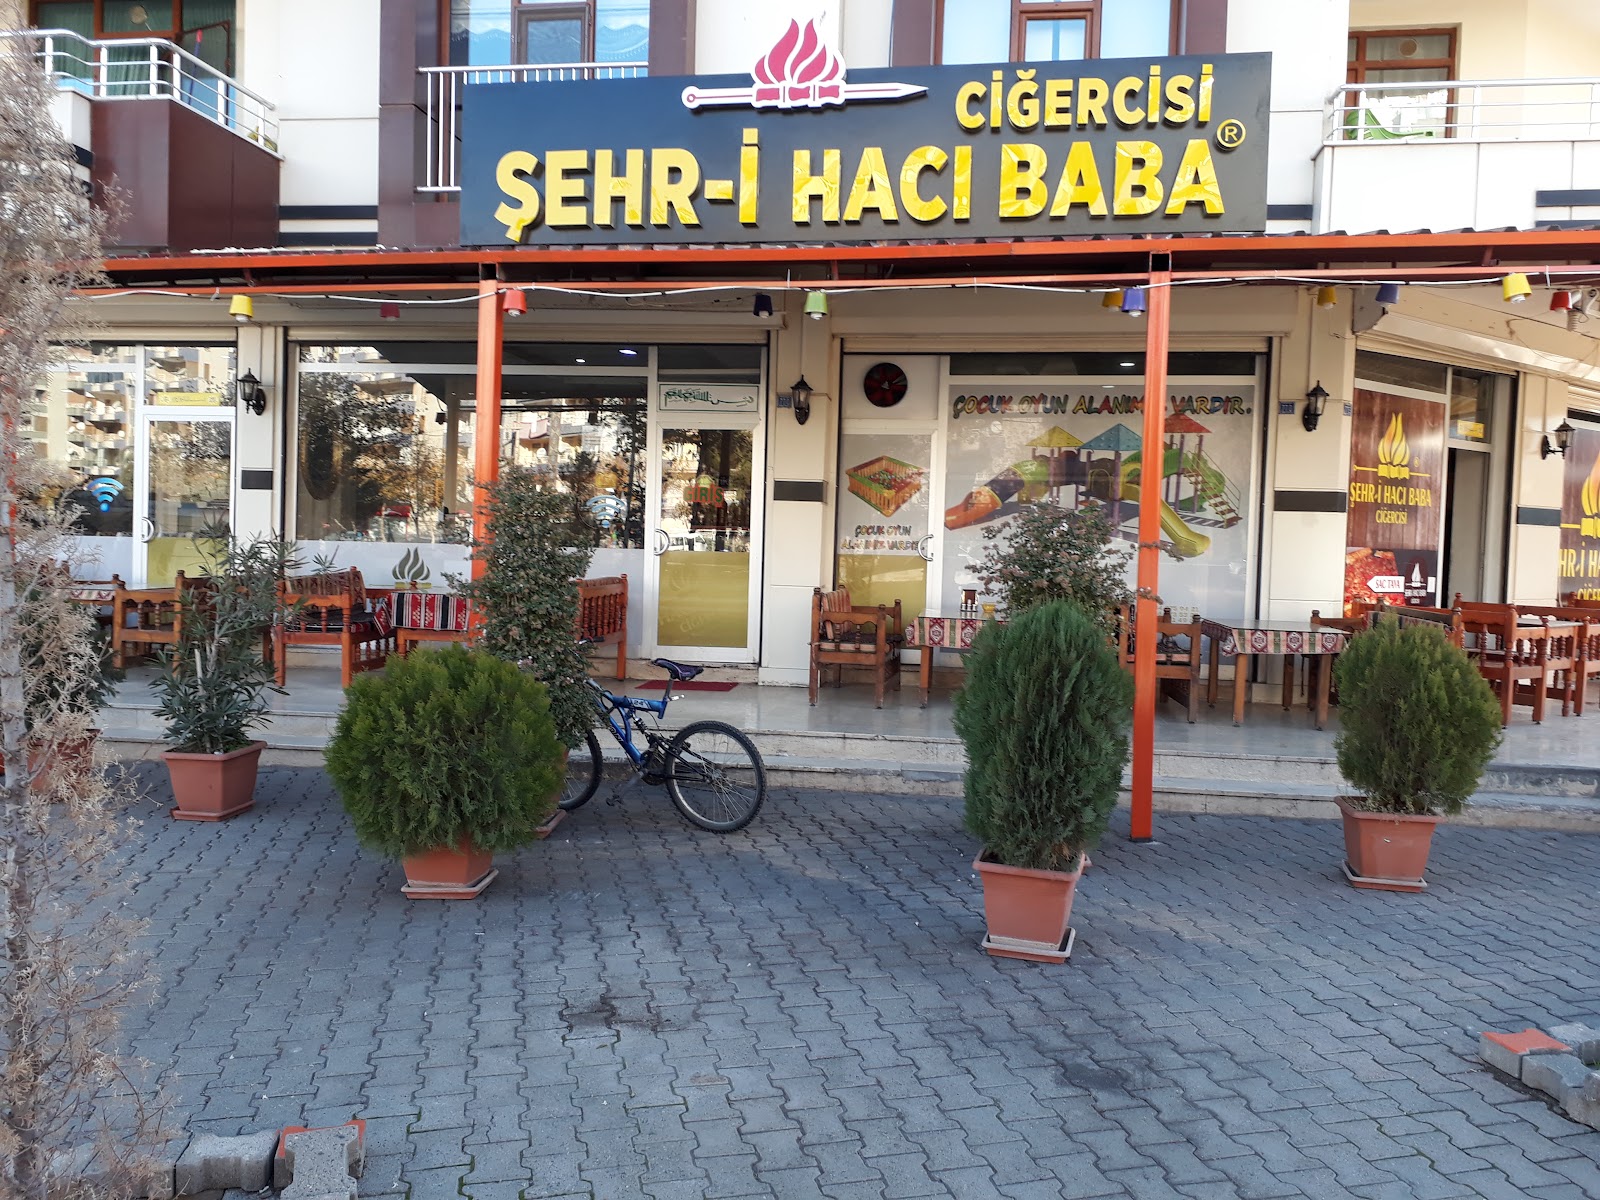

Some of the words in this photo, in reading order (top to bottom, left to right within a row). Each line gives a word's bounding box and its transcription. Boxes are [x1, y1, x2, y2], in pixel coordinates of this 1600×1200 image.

[955, 64, 1213, 129] CİĞERCİSİ
[494, 127, 759, 243] ŞEHR-İ
[792, 145, 972, 222] HACI
[999, 139, 1225, 218] BABA
[953, 394, 1013, 419] ÇOCUK
[1018, 392, 1069, 414] OYUN
[1072, 394, 1168, 414] ALANIM
[1349, 480, 1382, 508] ŞEHR-İ
[1384, 485, 1406, 505] HACI
[1408, 487, 1432, 507] BABA
[854, 524, 885, 538] ÇOCUK
[886, 524, 912, 536] OYUN
[1559, 540, 1586, 578] HR-İ
